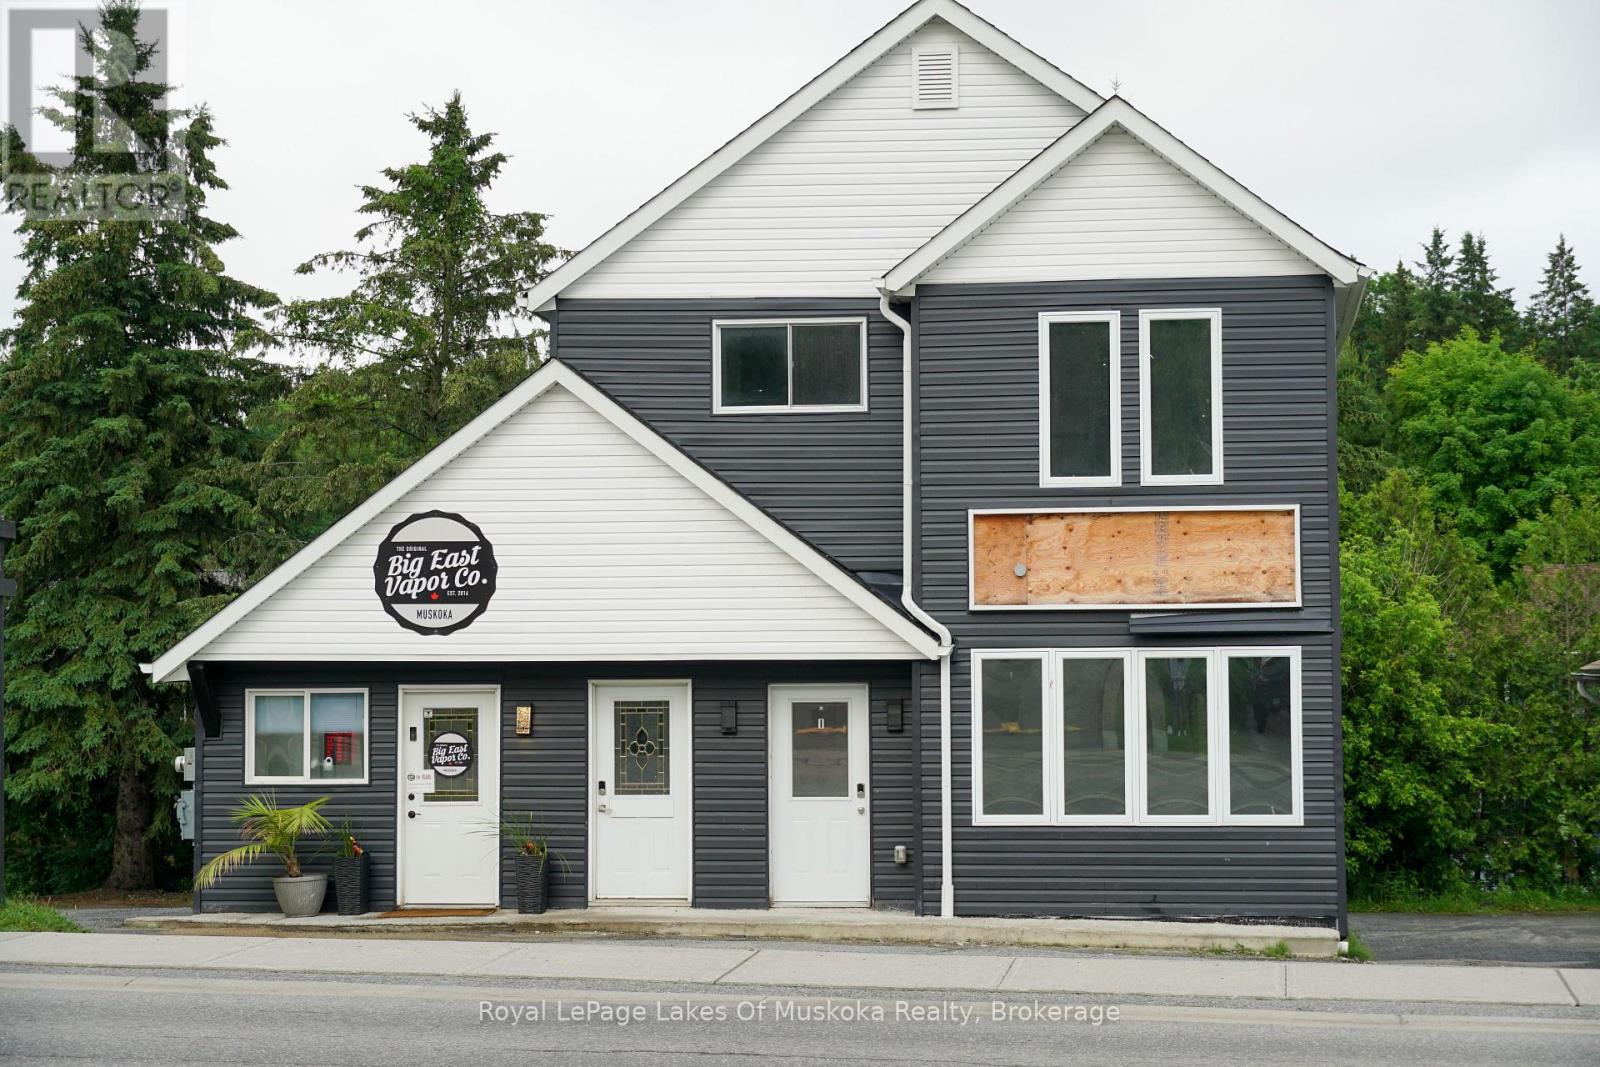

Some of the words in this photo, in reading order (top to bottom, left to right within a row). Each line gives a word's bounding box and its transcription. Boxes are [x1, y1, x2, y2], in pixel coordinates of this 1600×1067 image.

[388, 553, 424, 579] Big
[430, 545, 482, 570] East
[384, 571, 450, 599] Vapor
[454, 567, 488, 588] Co.
[416, 609, 453, 620] MUSKOKA
[432, 746, 447, 757] Big
[448, 744, 468, 754] East
[431, 754, 456, 765] Vapor
[457, 752, 471, 761] Co.
